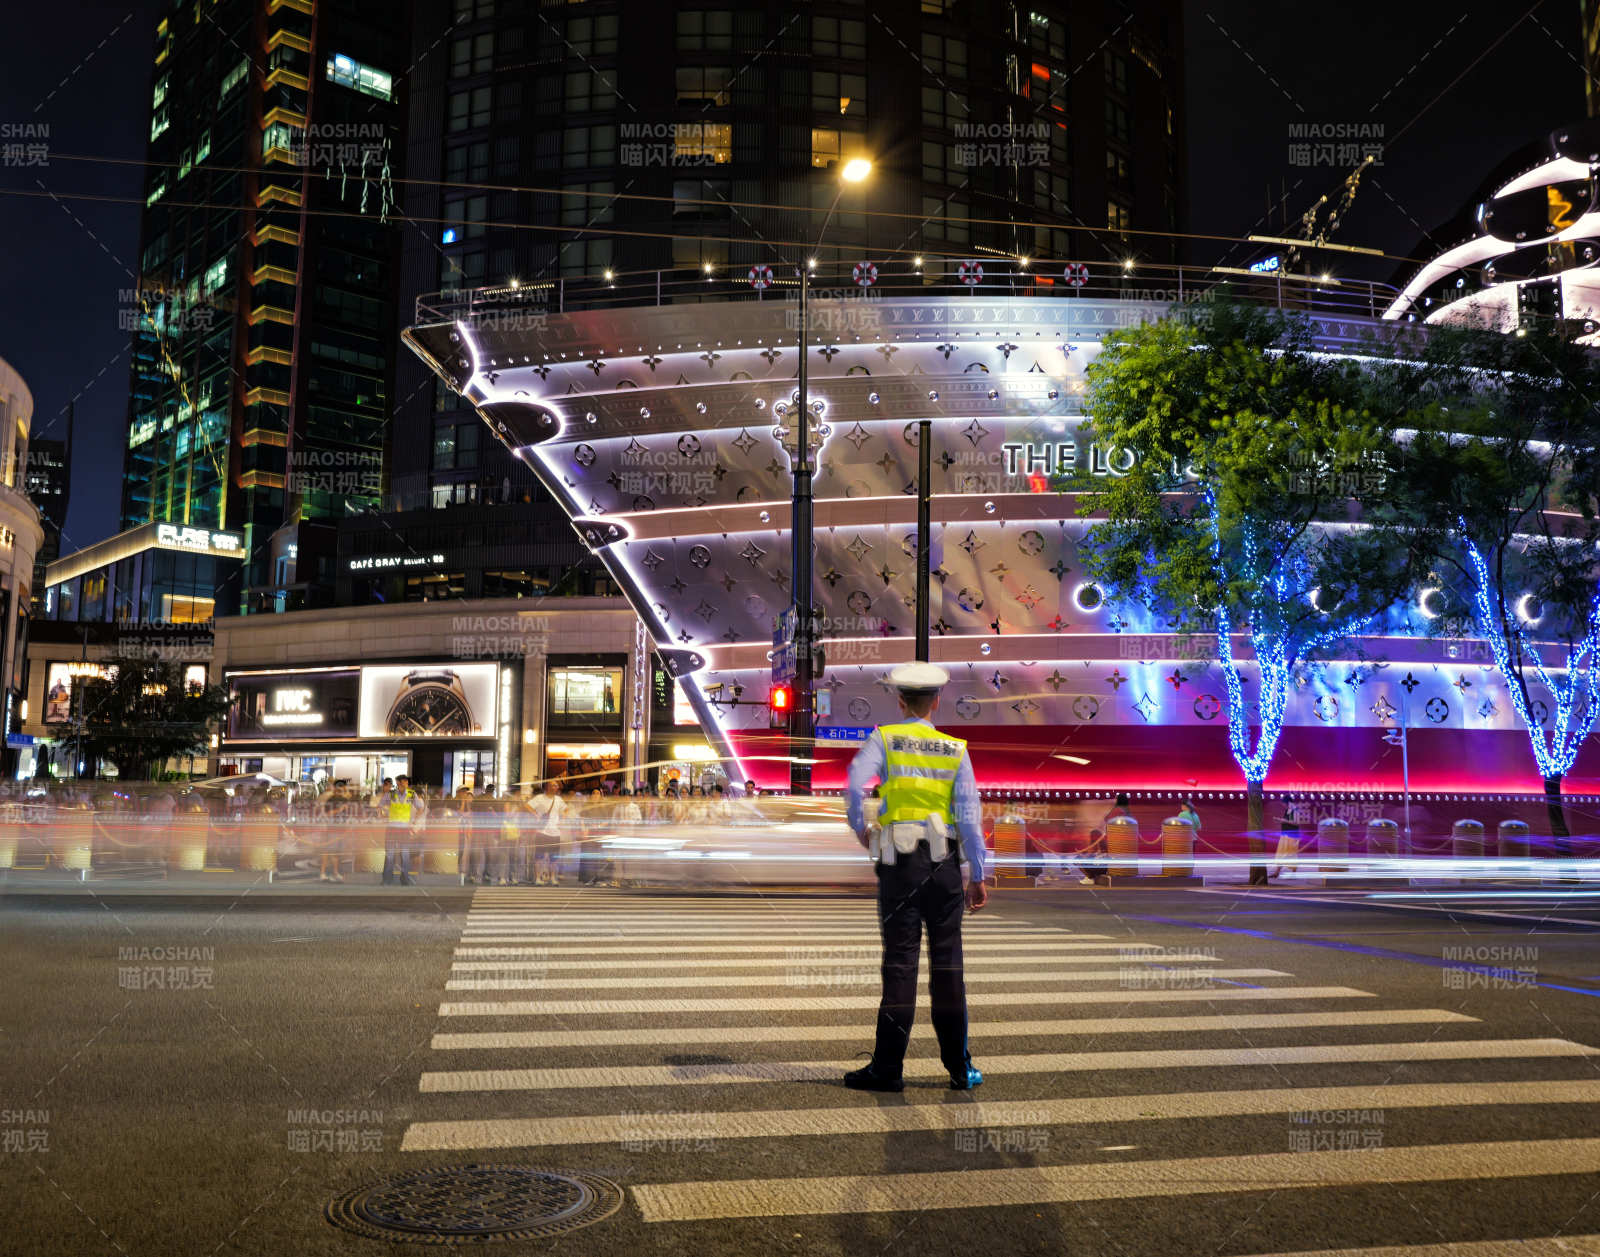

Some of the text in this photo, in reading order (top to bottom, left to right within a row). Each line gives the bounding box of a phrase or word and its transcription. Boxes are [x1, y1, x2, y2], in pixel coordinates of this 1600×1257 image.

[1002, 442, 1204, 477] THE LOI
[350, 557, 373, 569] CAFÉ
[375, 557, 401, 567] GRAY
[829, 728, 865, 739] 石门一路
[908, 738, 940, 753] POLICE
